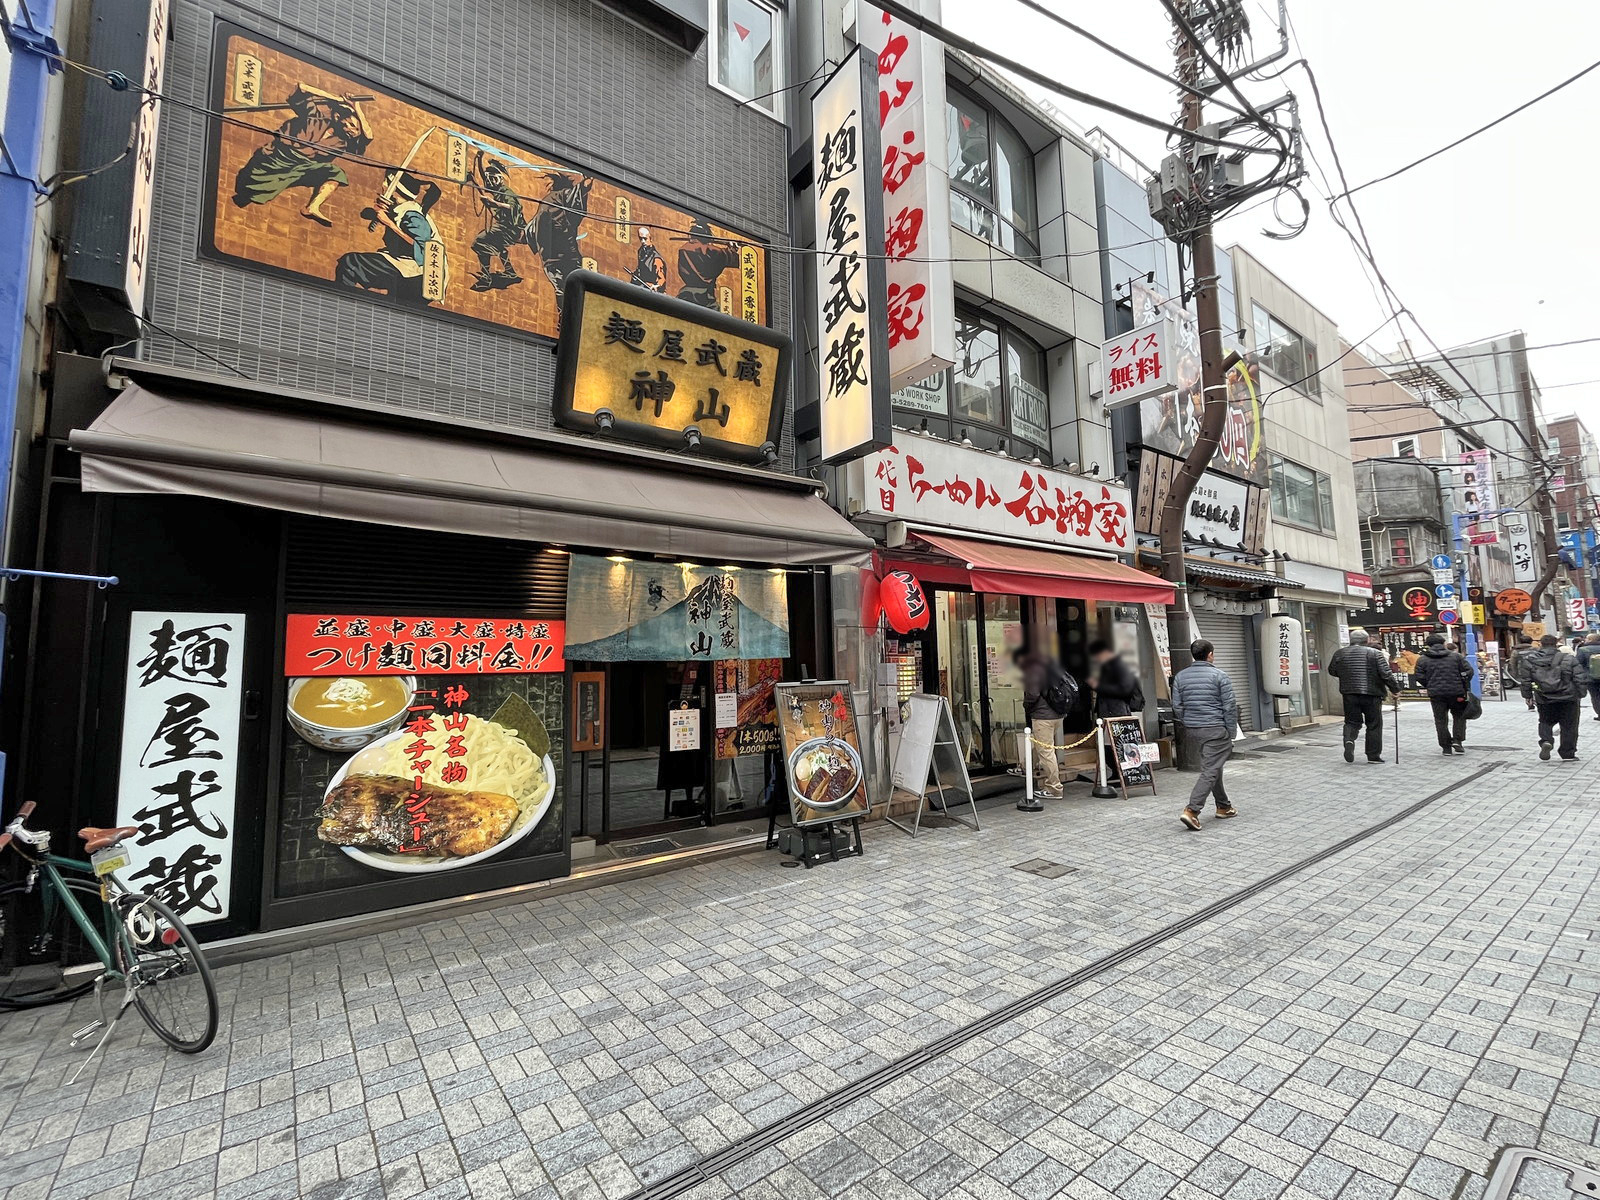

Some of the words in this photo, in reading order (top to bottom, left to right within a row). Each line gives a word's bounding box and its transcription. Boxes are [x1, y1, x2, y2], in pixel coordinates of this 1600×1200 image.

[600, 311, 763, 387] 麺屋武蔵
[1108, 332, 1159, 364] ライス
[905, 388, 924, 401] WORK
[925, 392, 941, 404] SHOP
[1108, 352, 1163, 395] 無料
[628, 370, 731, 427] 神山
[688, 601, 713, 657] 神山
[1571, 598, 1585, 631] クスリ
[440, 685, 470, 784] 神山名物
